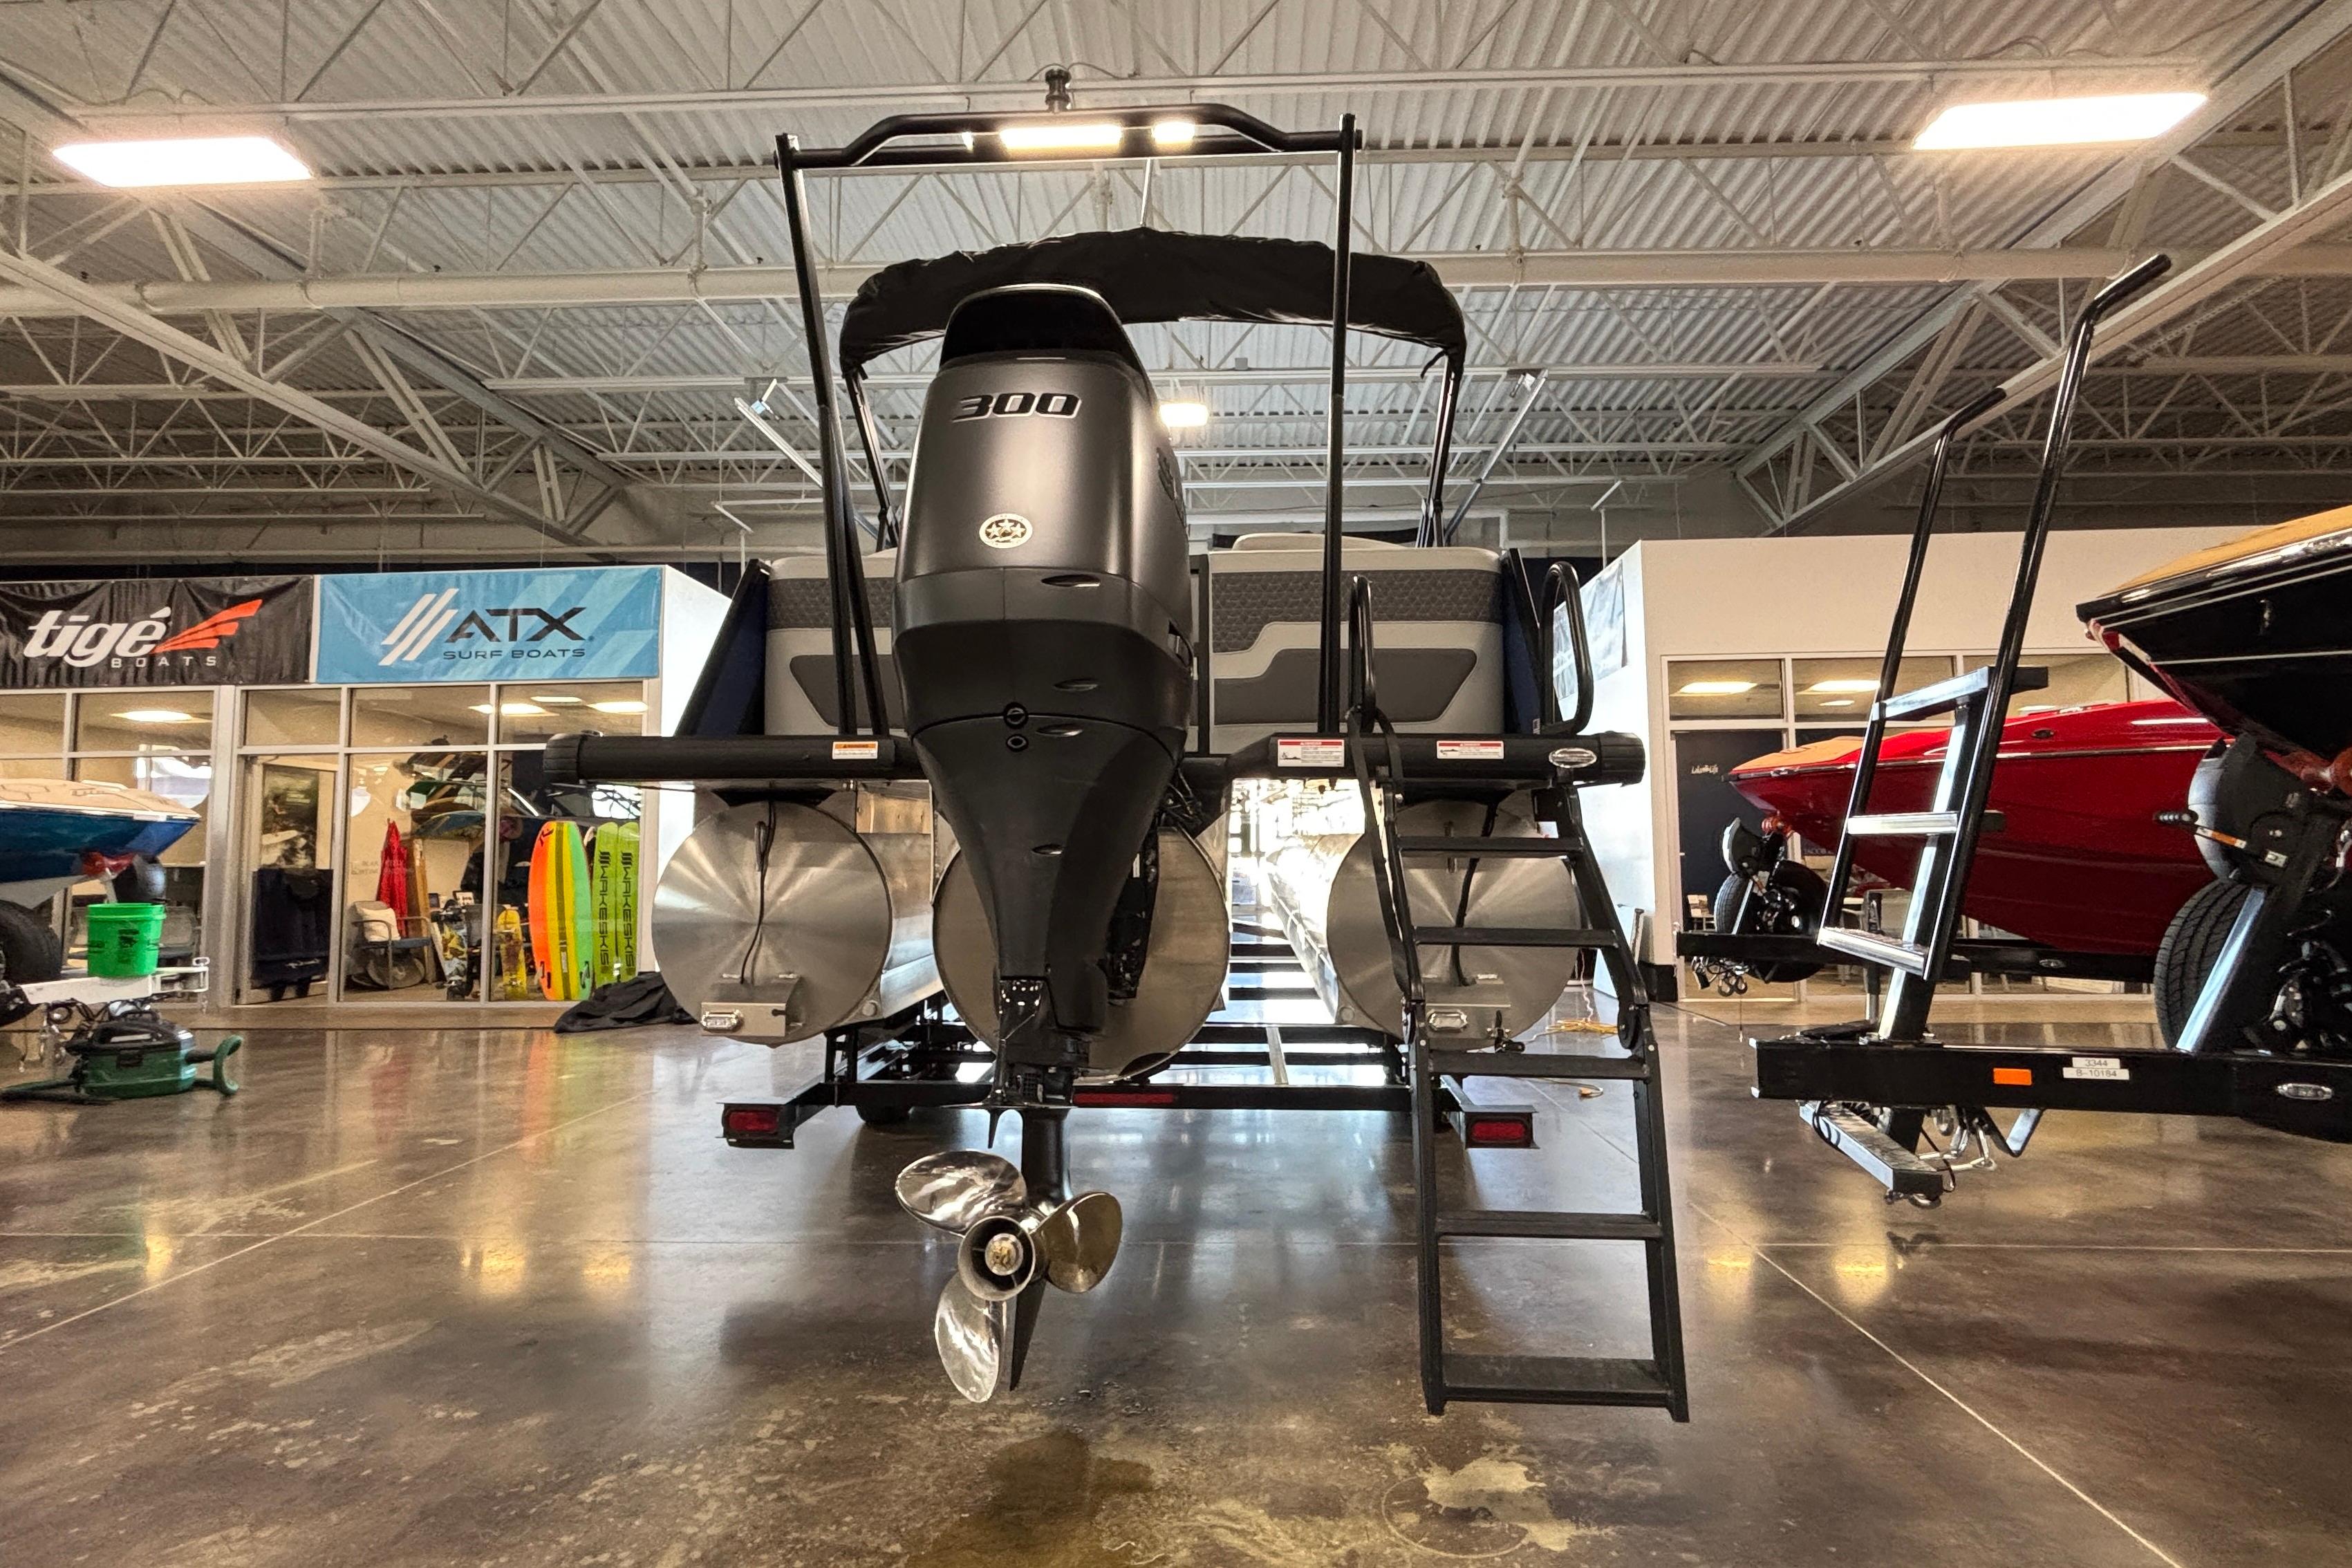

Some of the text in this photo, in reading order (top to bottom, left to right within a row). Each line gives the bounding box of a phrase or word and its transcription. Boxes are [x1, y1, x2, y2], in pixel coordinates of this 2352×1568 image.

[951, 392, 1083, 423] 300
[444, 607, 587, 643] ATX
[24, 606, 172, 668] tigé
[111, 656, 217, 669] BOATS
[442, 648, 586, 660] SURF BOATS
[2084, 1058, 2109, 1067] 3344
